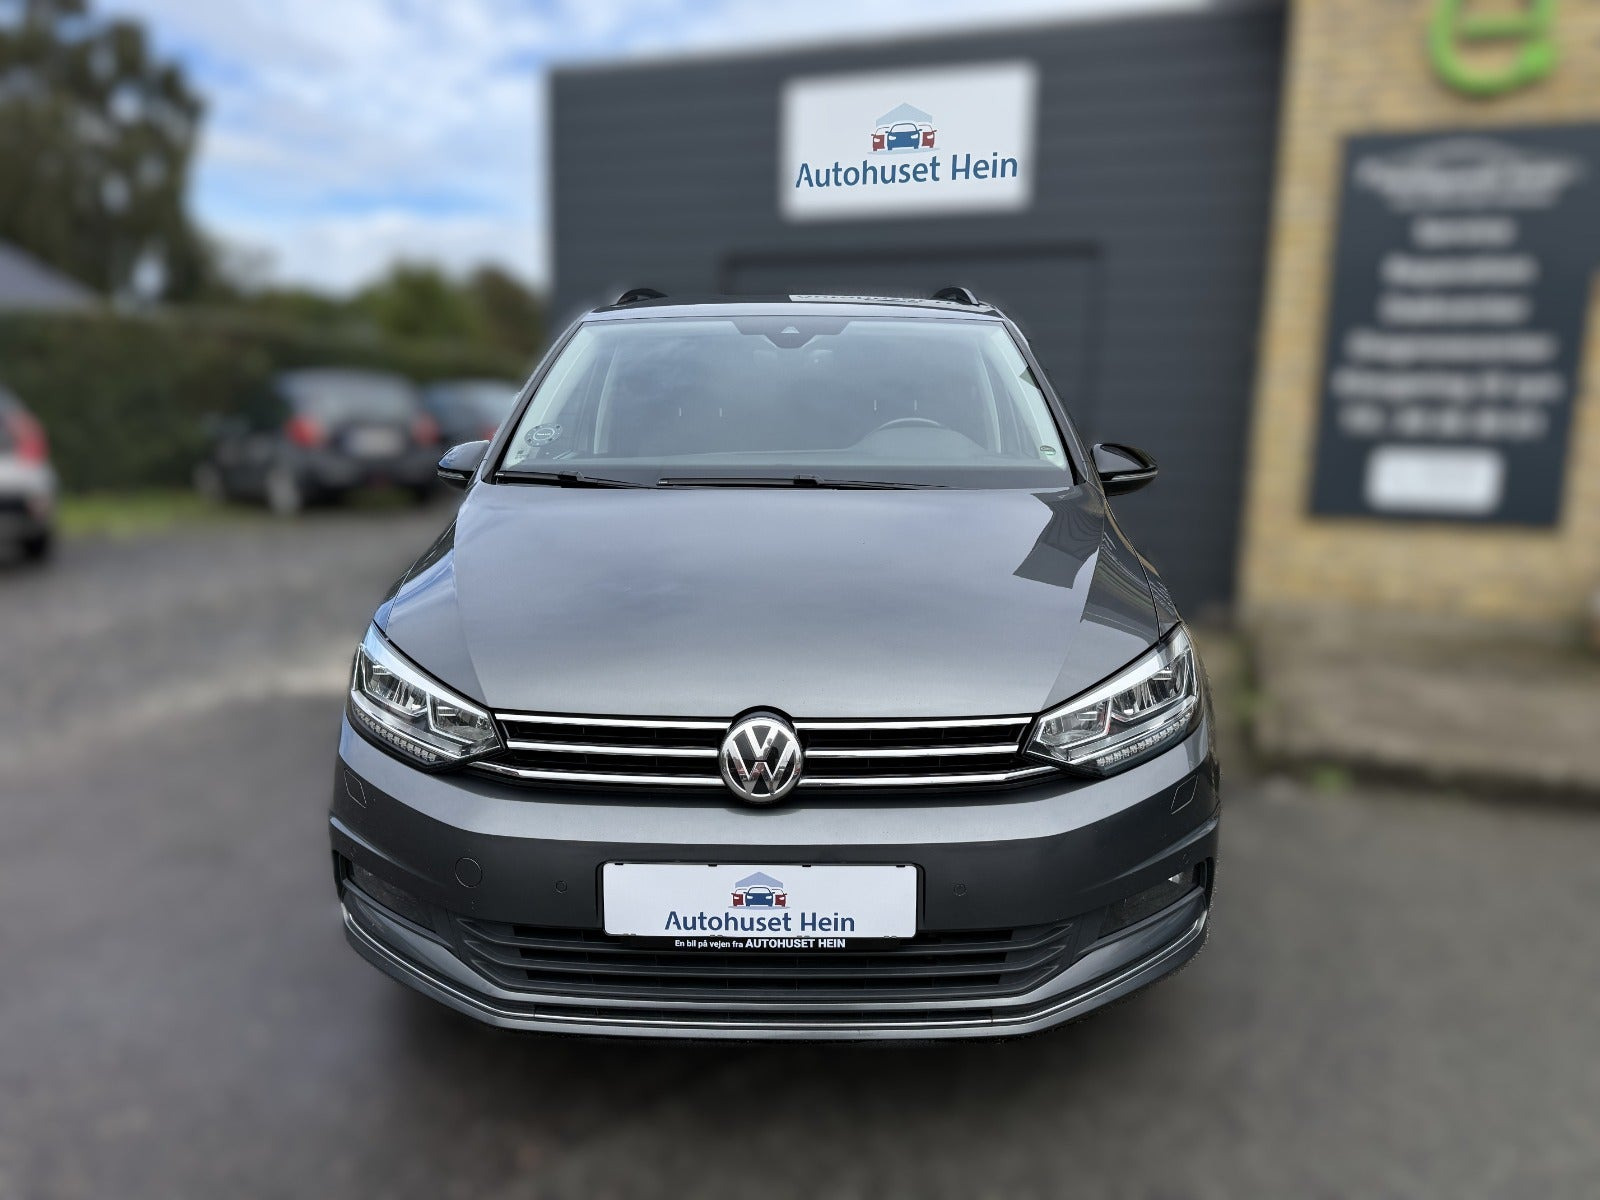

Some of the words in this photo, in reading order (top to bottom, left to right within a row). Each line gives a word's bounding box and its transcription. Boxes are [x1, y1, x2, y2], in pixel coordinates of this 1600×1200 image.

[795, 156, 941, 188] Autohuset
[951, 151, 1019, 181] Hein
[664, 911, 792, 932] Autohuset
[800, 912, 855, 932] Hein
[674, 939, 685, 948] En
[686, 939, 697, 948] bil
[698, 940, 708, 950] på
[709, 940, 731, 950] vejen
[732, 939, 744, 948] fra
[745, 938, 815, 949] AUTOHUSET
[818, 939, 846, 949] HEIN
